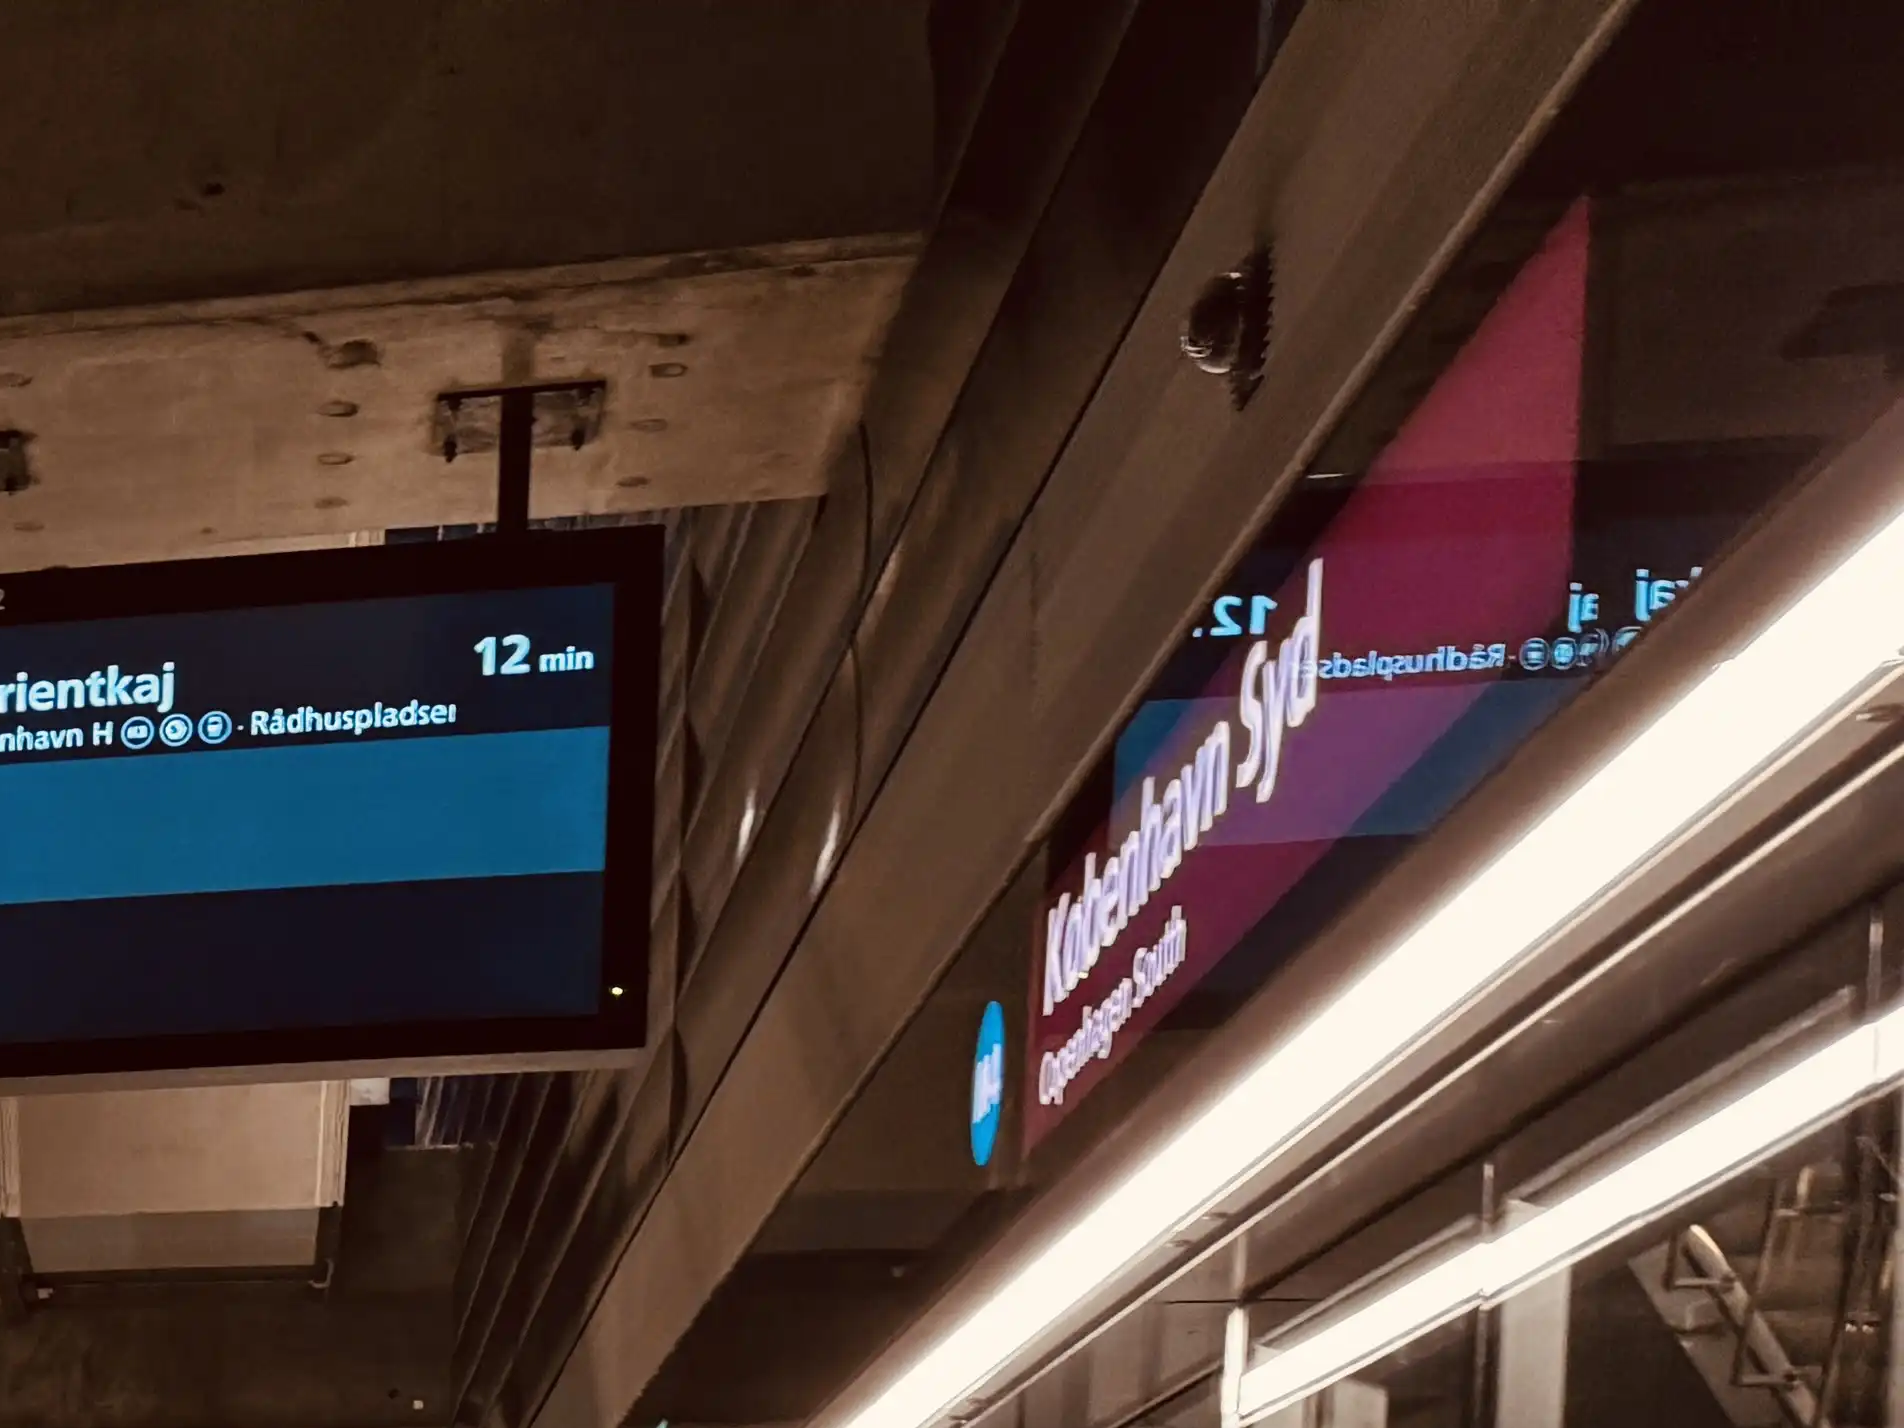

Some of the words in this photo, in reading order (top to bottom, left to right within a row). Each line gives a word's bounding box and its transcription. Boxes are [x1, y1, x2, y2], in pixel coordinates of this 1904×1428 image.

[474, 634, 531, 676] 12
[538, 646, 594, 673] min
[1235, 558, 1324, 803] Syd
[92, 721, 114, 747] H
